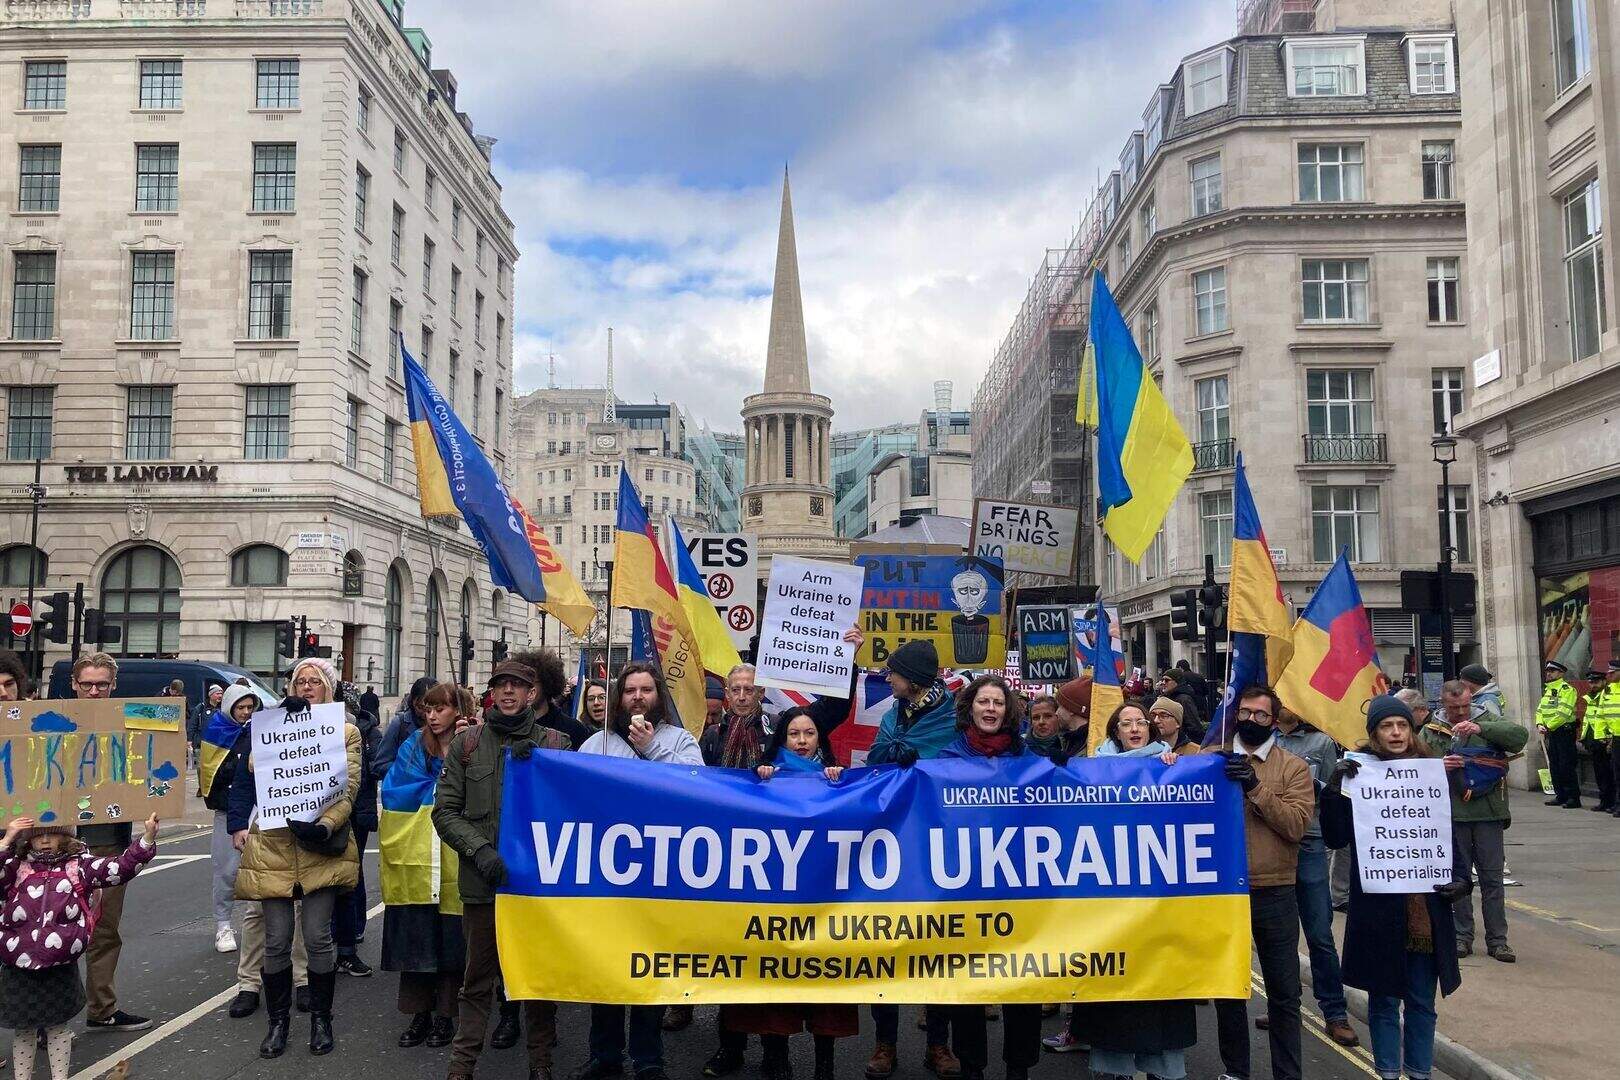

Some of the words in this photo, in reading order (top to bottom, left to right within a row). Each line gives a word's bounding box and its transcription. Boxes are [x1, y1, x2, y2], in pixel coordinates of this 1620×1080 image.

[64, 466, 107, 483] THE
[113, 465, 219, 483] LANGHAM
[990, 506, 1053, 530] FEAR
[1007, 544, 1069, 568] PEACE
[802, 571, 832, 585] Arm
[864, 559, 927, 582] PUT
[779, 584, 833, 603] Ukraine
[838, 594, 851, 606] to
[790, 605, 835, 621] defeat
[895, 612, 938, 631] THE
[1024, 611, 1066, 633] ARM
[781, 620, 840, 640] Russian
[772, 636, 829, 655] fascism
[834, 645, 844, 657] &
[763, 653, 848, 676] imperialism
[1029, 660, 1068, 679] NOW
[283, 711, 312, 724] Arm
[261, 728, 316, 745] Ukraine
[321, 725, 335, 735] to
[279, 743, 321, 760] defeat
[273, 762, 330, 780] Russian
[1385, 767, 1418, 780] Arm
[268, 781, 323, 798] fascism
[328, 776, 340, 788] &
[943, 786, 1018, 806] UKRAINE
[1023, 784, 1122, 804] SOLIDARITY
[1127, 783, 1214, 802] CAMPAIGN
[1361, 786, 1424, 799] Ukraine
[1429, 786, 1441, 798] to
[263, 789, 344, 817] imperialism
[1380, 805, 1431, 818] defeat
[1375, 826, 1438, 839] Russian
[530, 821, 815, 891] VICTORY
[827, 828, 902, 891] TO
[929, 823, 1218, 889] UKRAINE
[1369, 845, 1433, 859] fascism
[1436, 845, 1445, 858] &
[1364, 866, 1453, 882] imperialism
[744, 915, 816, 941] ARM
[828, 913, 965, 941] UKRAINE
[976, 911, 1014, 937] TO
[630, 953, 748, 978] DEFEAT
[759, 955, 895, 979] RUSSIAN
[908, 951, 1126, 979] IMPERIALISM!
